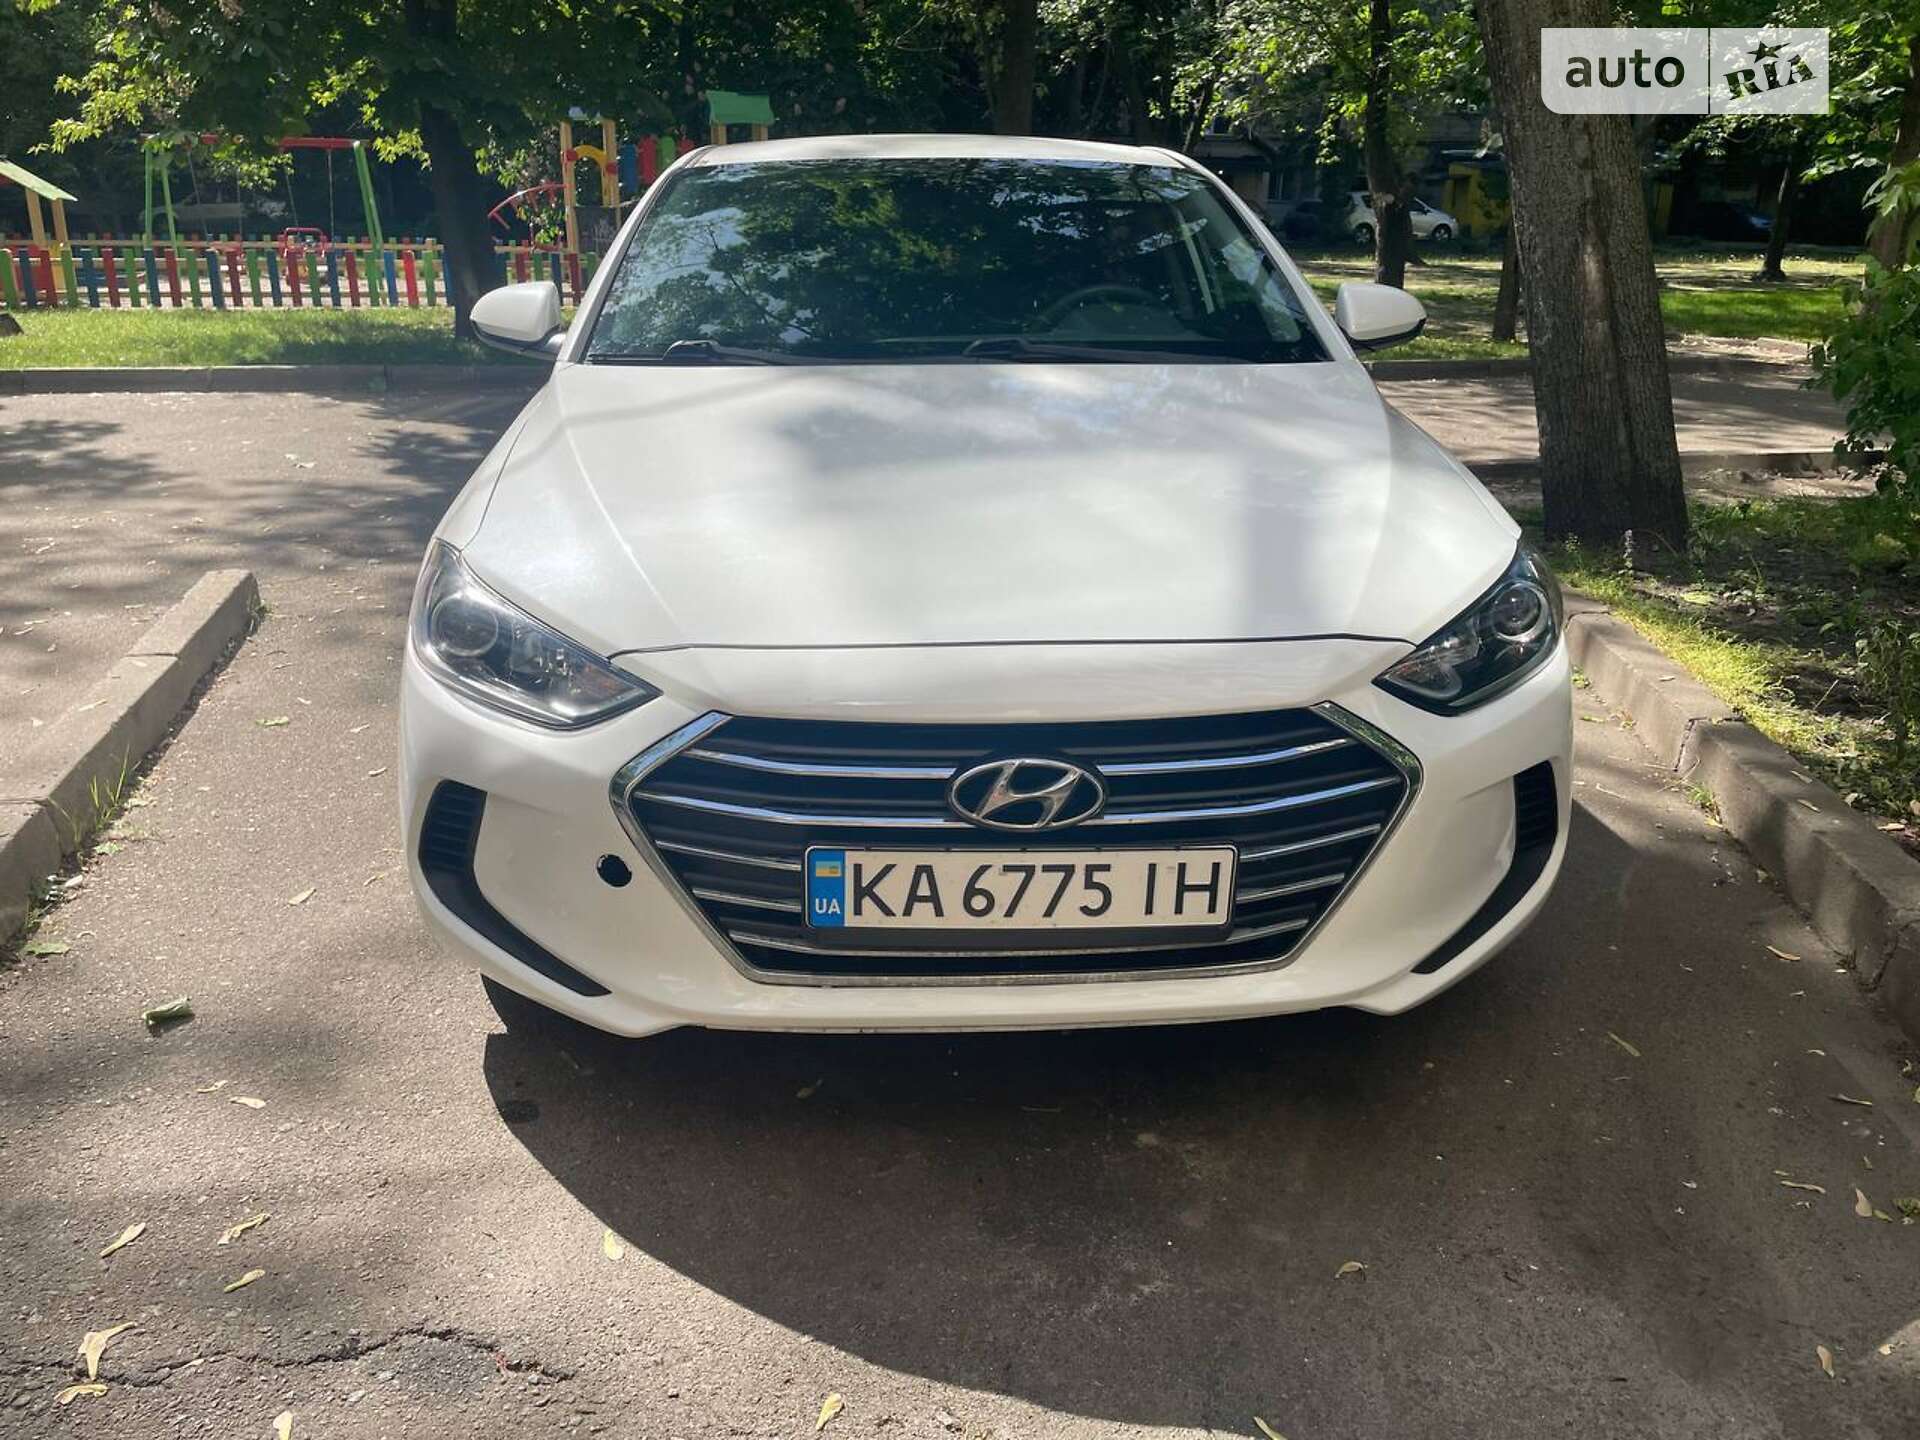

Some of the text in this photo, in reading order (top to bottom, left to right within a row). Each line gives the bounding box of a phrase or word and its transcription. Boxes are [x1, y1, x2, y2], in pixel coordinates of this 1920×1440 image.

[815, 898, 841, 914] UA
[852, 862, 1222, 919] KA 6775 IH
